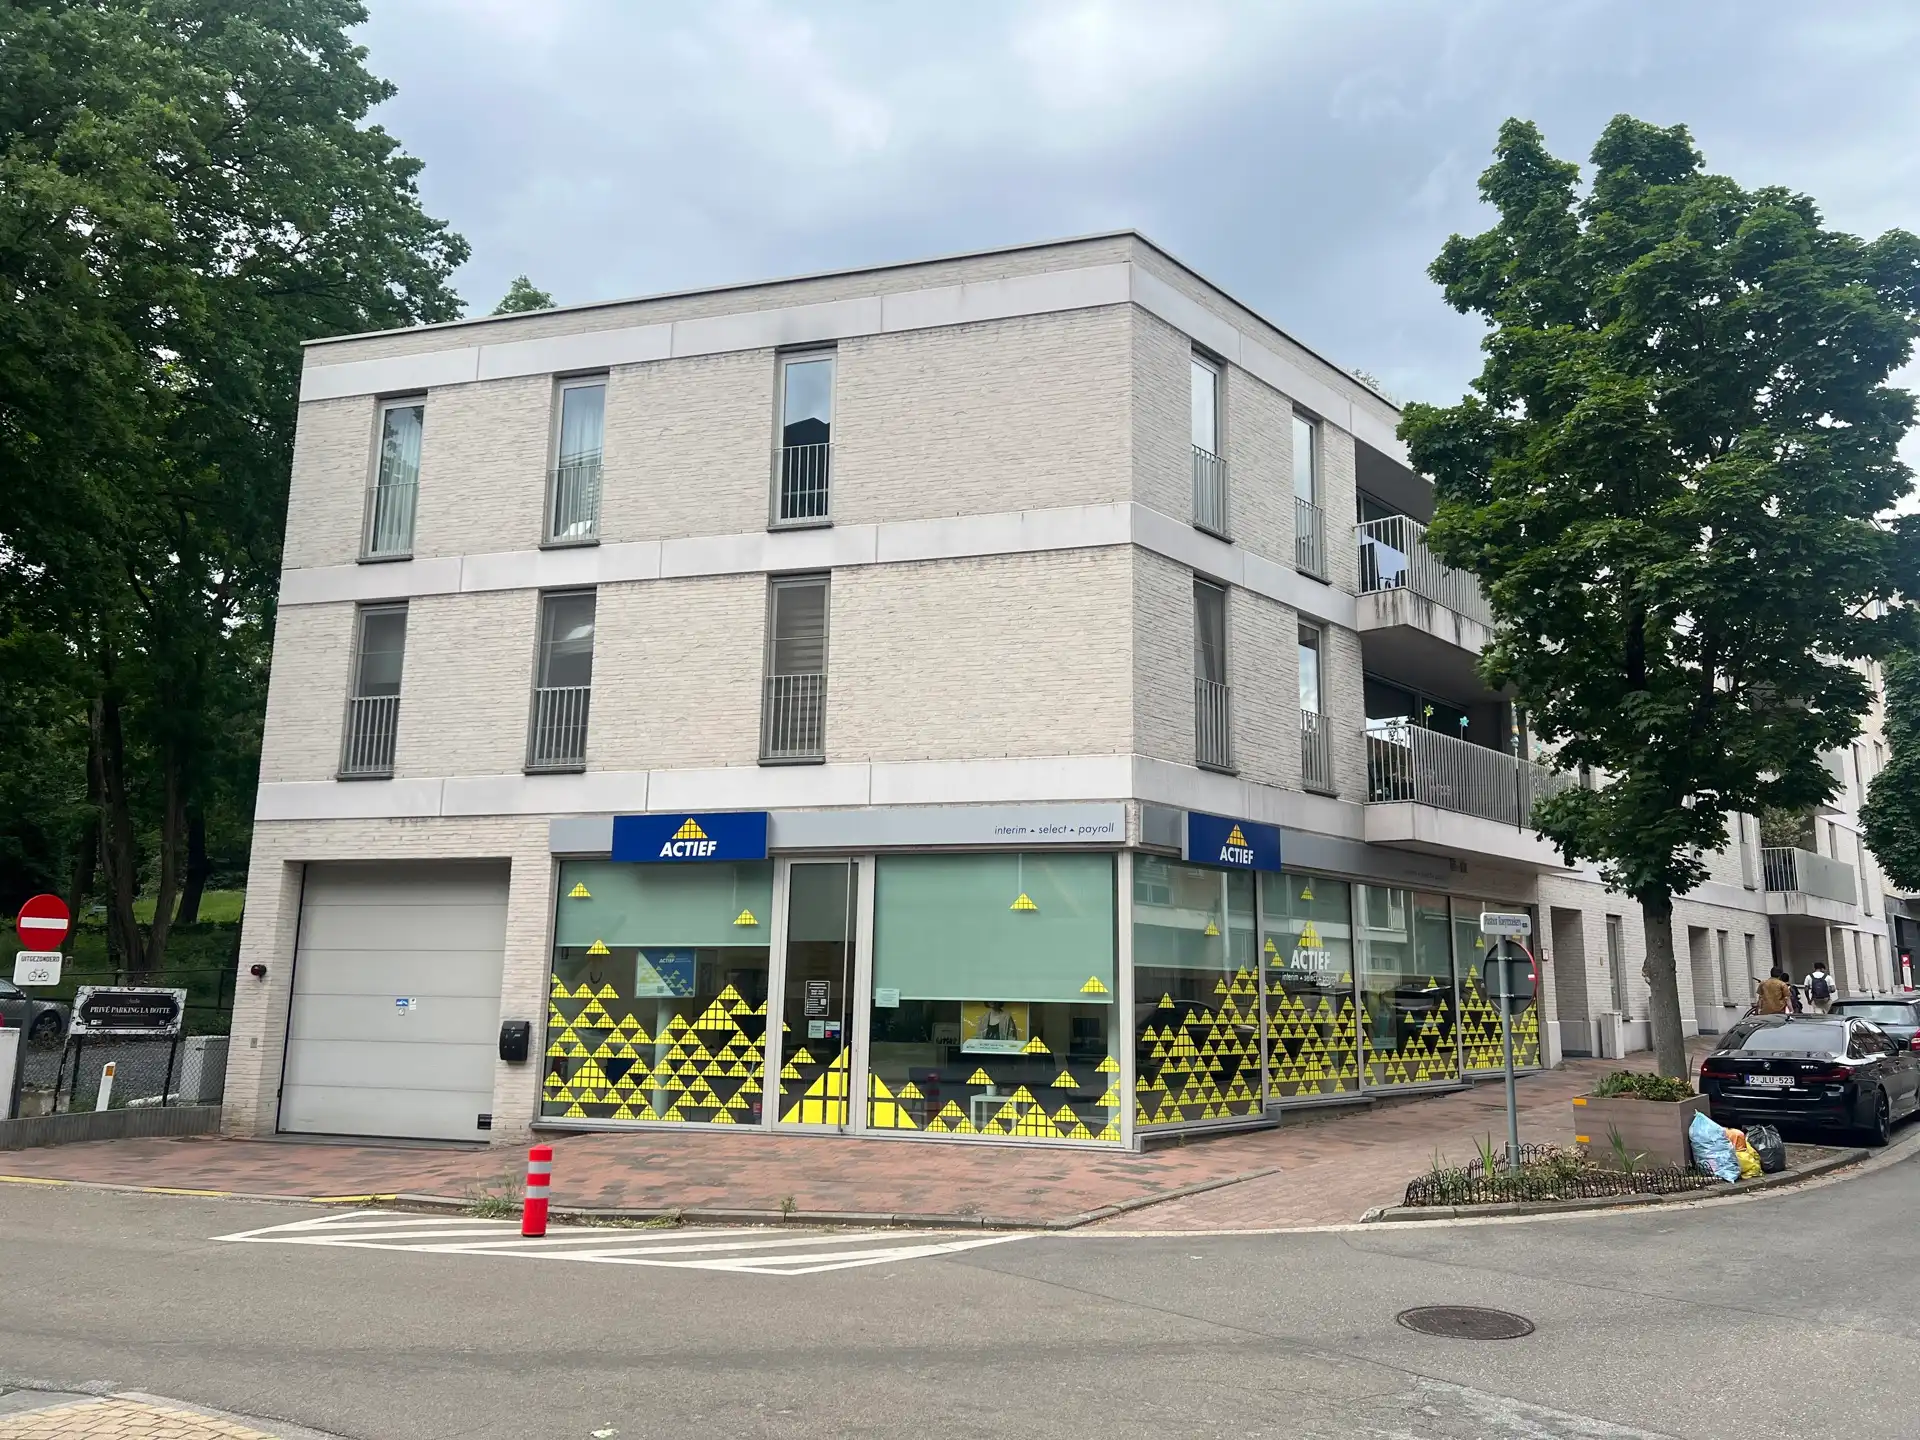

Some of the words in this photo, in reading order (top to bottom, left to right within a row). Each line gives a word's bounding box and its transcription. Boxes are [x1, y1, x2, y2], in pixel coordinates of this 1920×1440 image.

[994, 825, 1027, 835] interim
[1038, 823, 1067, 834] select
[1078, 822, 1115, 836] payroll
[659, 841, 717, 857] ACTIEF
[1219, 845, 1254, 865] ACTIEF
[20, 955, 61, 963] UITGEZONDERD
[1290, 950, 1331, 969] ACTIEF
[111, 1006, 140, 1014] PARKING
